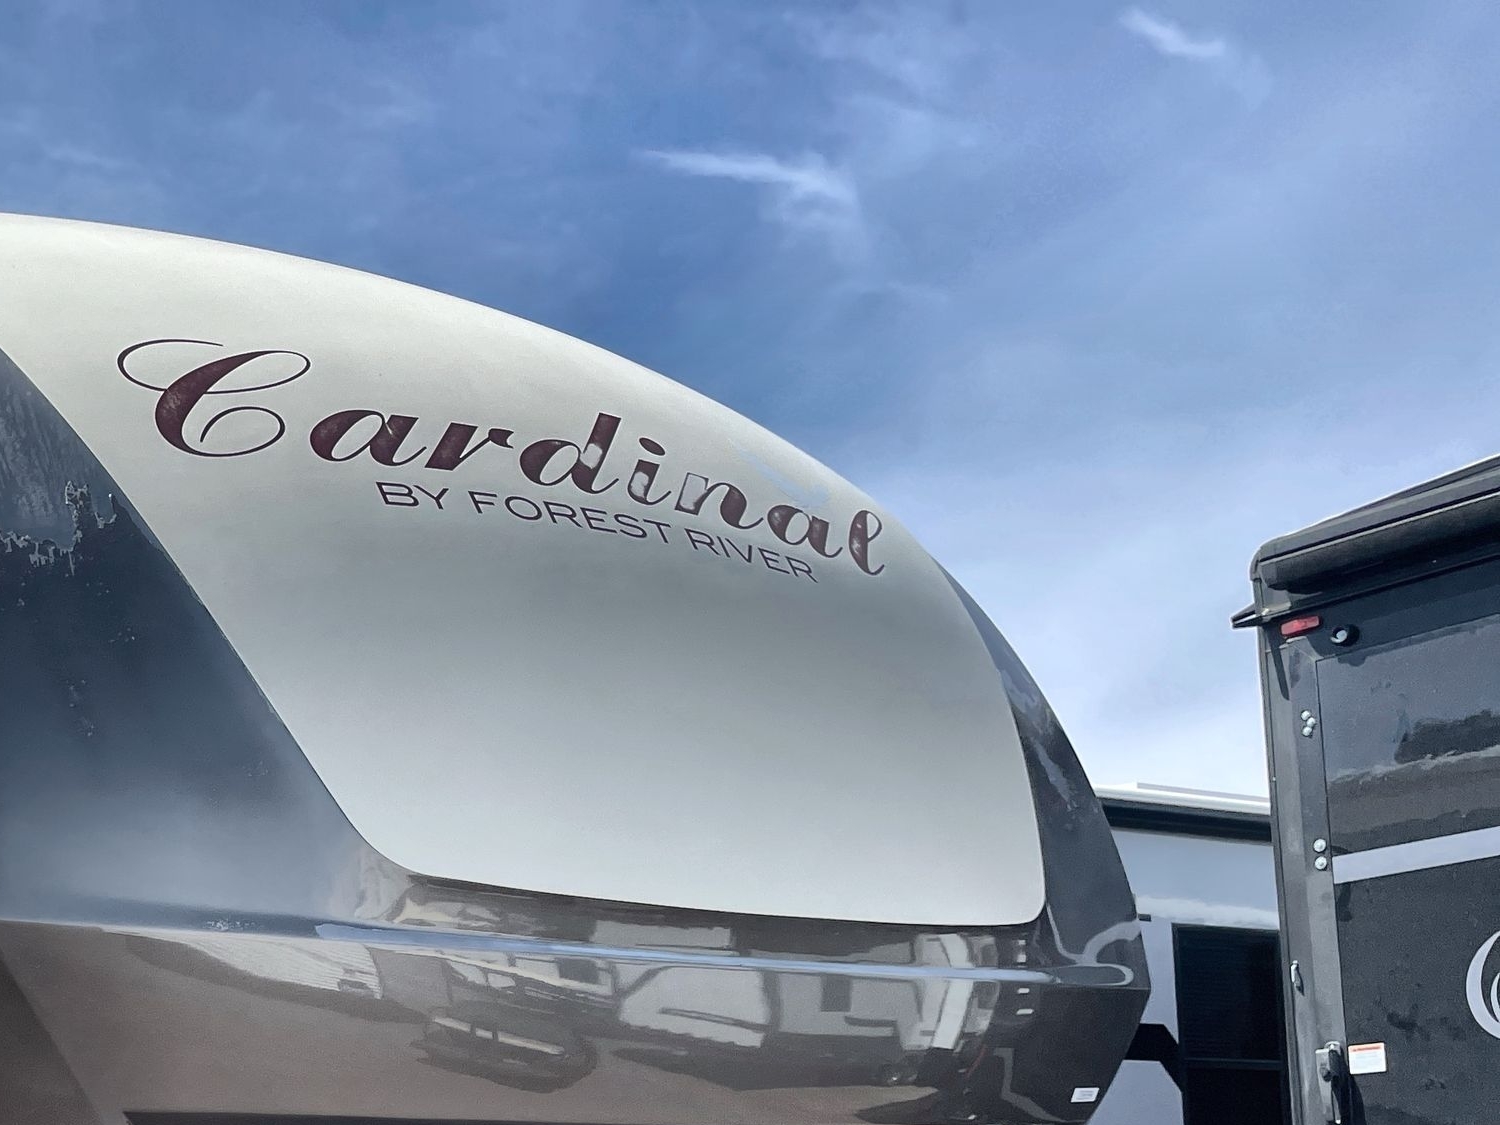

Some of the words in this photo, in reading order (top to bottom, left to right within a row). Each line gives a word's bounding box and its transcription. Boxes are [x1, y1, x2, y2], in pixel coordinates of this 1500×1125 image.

[117, 338, 886, 577] Cardinal
[375, 480, 450, 510] BY
[467, 490, 672, 545] FOREST
[683, 527, 819, 584] RIVER
